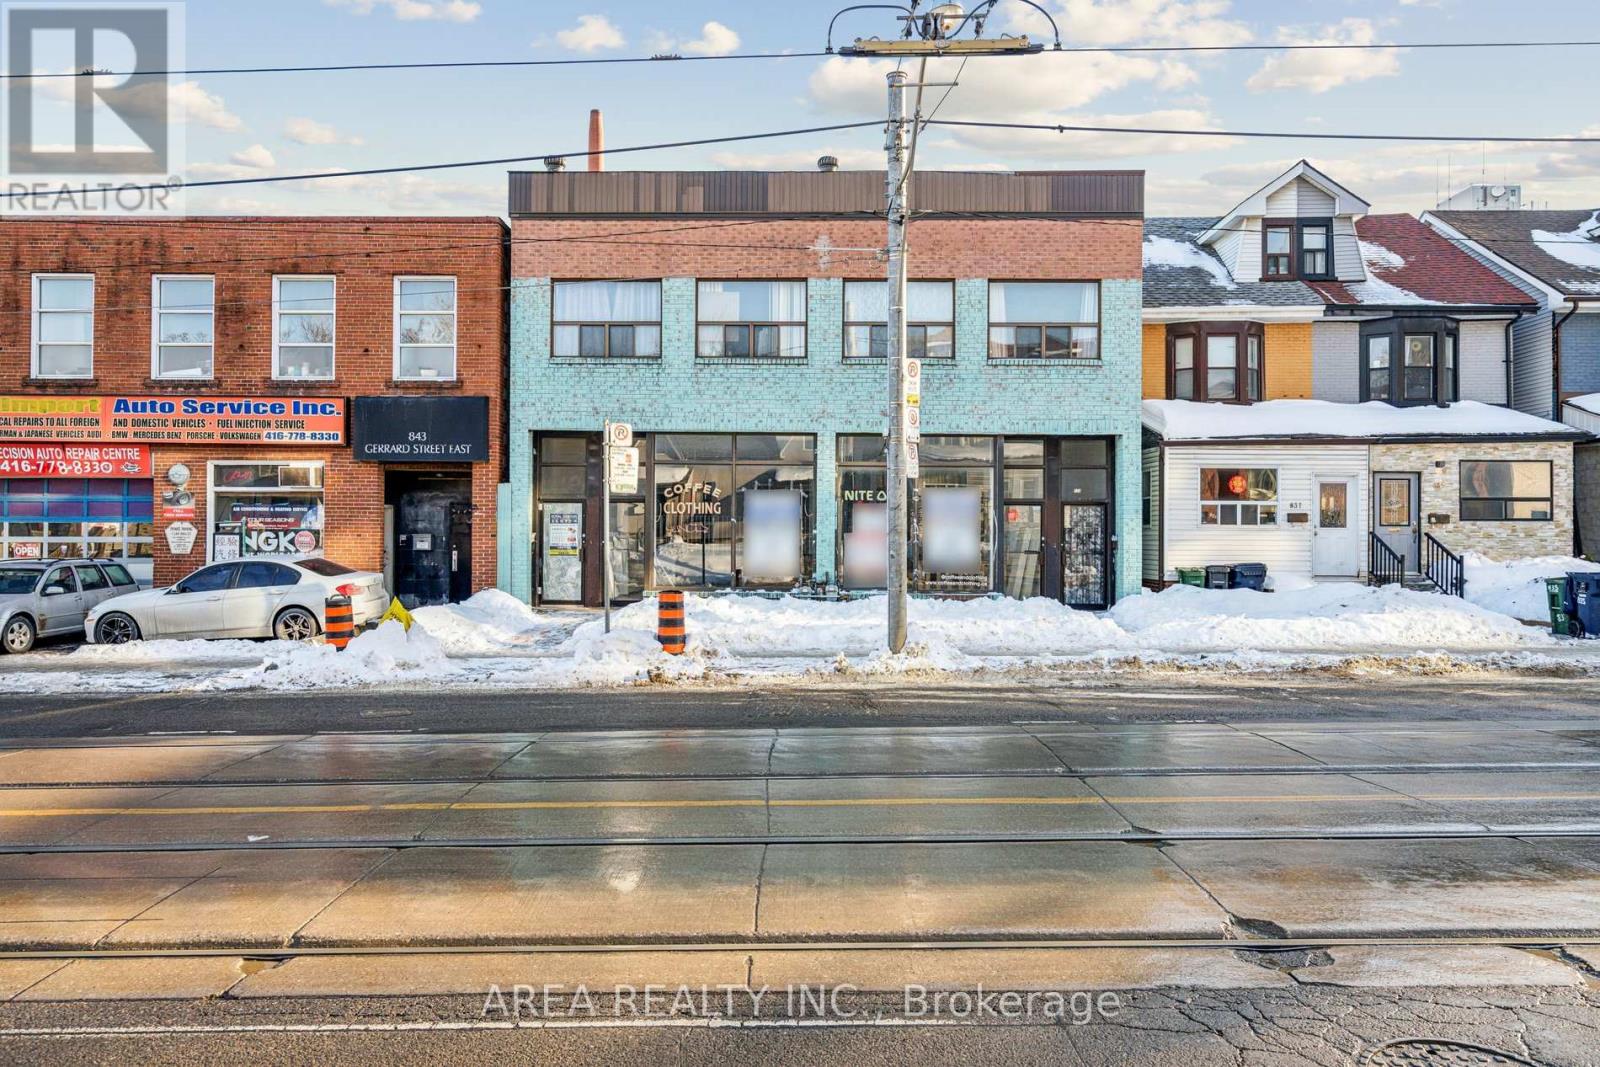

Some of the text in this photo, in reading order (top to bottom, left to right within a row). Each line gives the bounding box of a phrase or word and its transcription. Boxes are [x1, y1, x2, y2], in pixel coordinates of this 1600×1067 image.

[113, 398, 175, 414] Auto
[182, 399, 286, 415] Service
[292, 400, 342, 416] Inc.
[14, 417, 44, 427] REPAIRS
[46, 417, 55, 427] TO
[57, 417, 68, 427] ALL
[70, 417, 100, 427] FOREIGN
[113, 418, 128, 428] AND
[131, 418, 169, 428] DOMESTIC
[172, 418, 206, 428] VEHICLES
[217, 419, 233, 429] FUEL
[235, 419, 271, 429] INJECTION
[275, 420, 305, 430] SERVICE
[24, 430, 53, 438] JAPANESE
[56, 430, 84, 438] VEHICLES
[87, 430, 101, 438] AUDI
[111, 430, 128, 439] BMW
[133, 430, 165, 439] MERCEDES
[167, 431, 182, 440] BENZ
[186, 431, 215, 440] PORSCHE
[219, 431, 262, 441] VOLKSWAGEN
[265, 431, 339, 441] 416-778-8330
[408, 431, 428, 442] 843
[36, 447, 62, 459] AUTO
[65, 447, 100, 460] REPAIR
[102, 447, 140, 460] CENTRE
[364, 443, 472, 454] GERRARD STREET EAST
[1, 459, 113, 474] 416-778-8330
[663, 483, 722, 498] COFFEE
[844, 490, 874, 501] NITE
[663, 502, 722, 515] CLOTHING
[244, 531, 297, 552] NGK
[15, 547, 40, 557] OPEN
